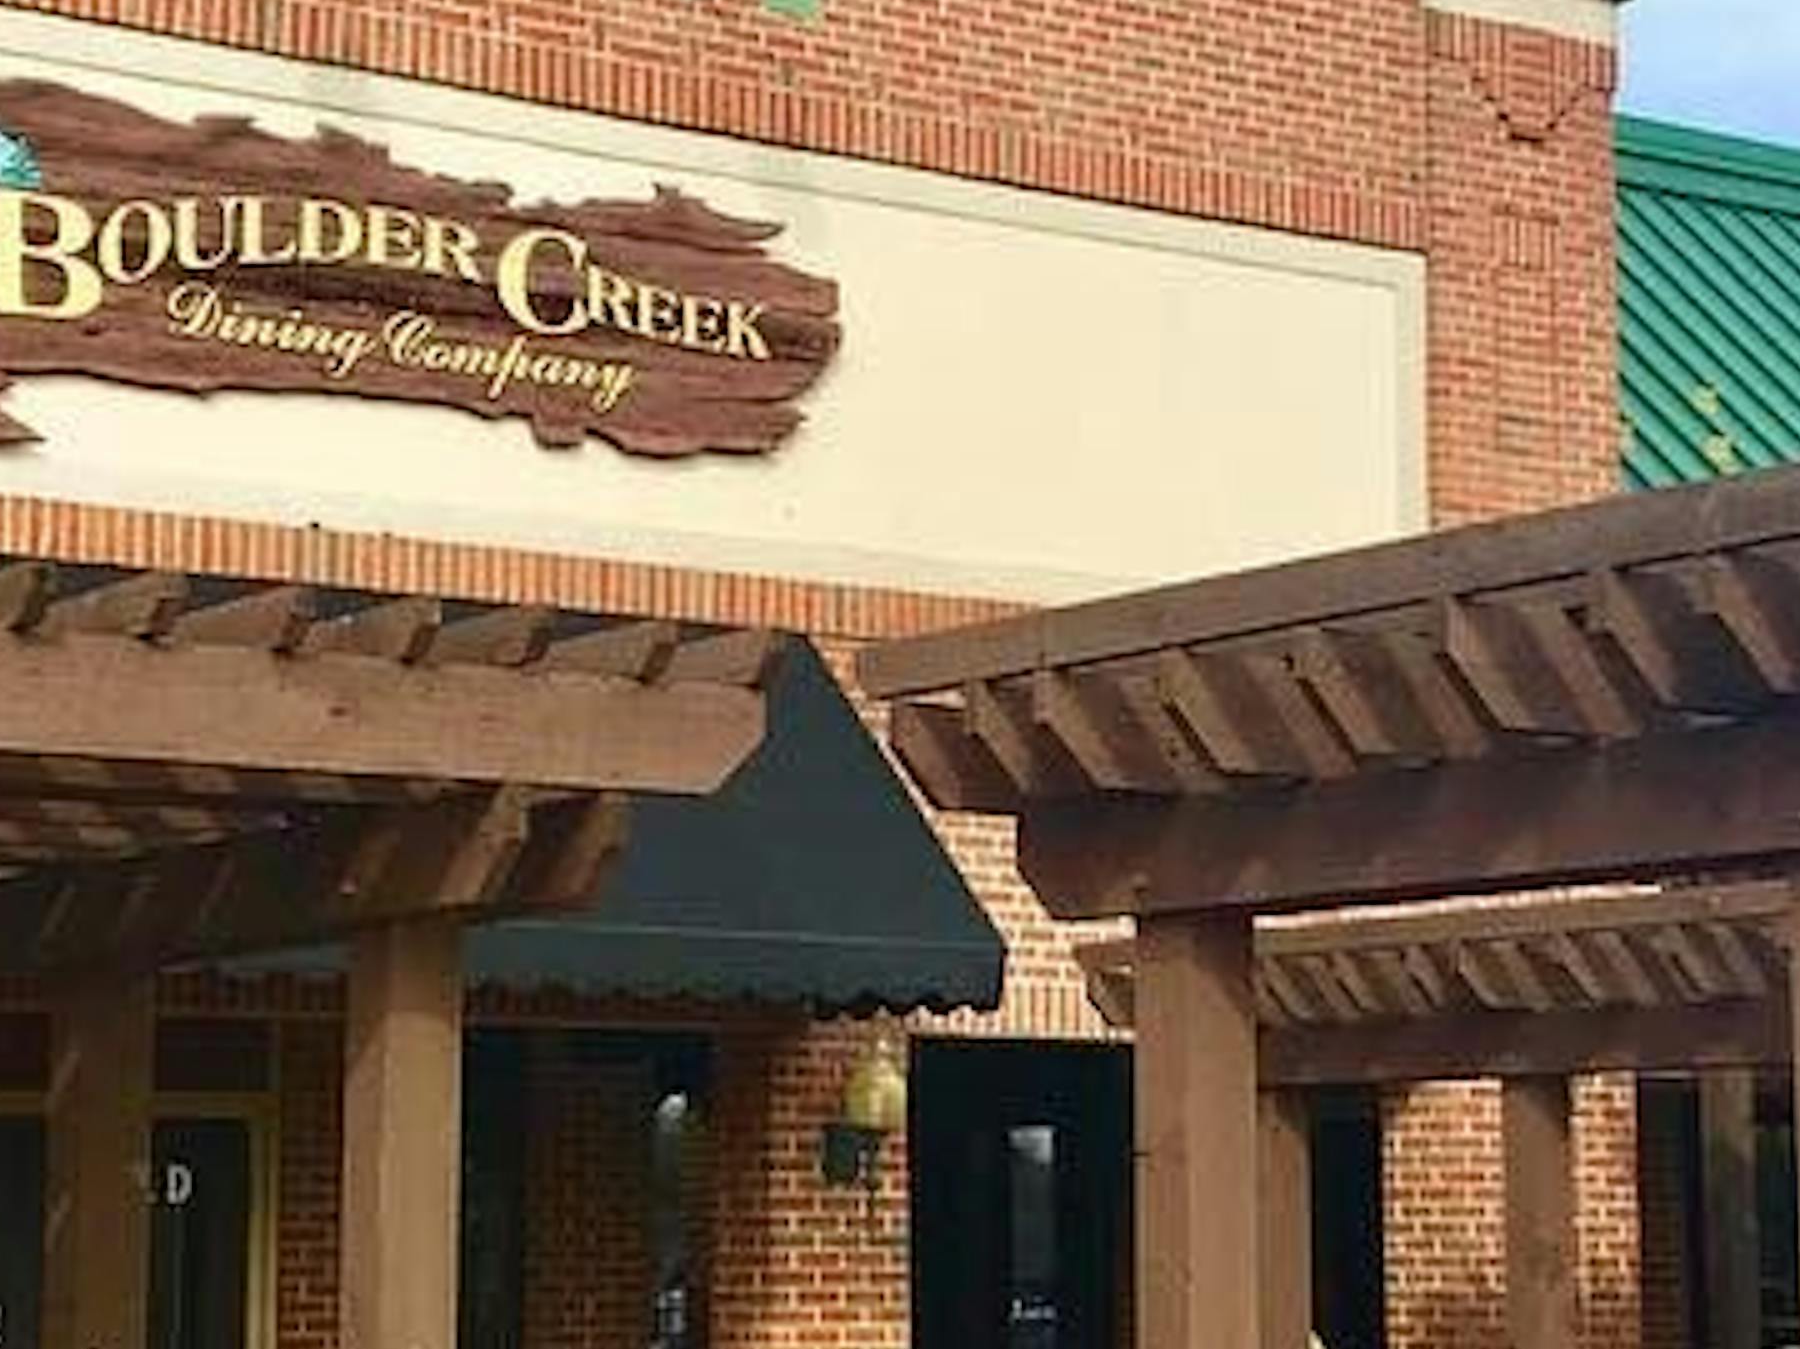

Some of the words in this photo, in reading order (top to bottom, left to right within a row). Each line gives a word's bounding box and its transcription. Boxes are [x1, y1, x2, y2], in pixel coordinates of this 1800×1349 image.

[167, 281, 374, 379] Dining
[382, 308, 639, 413] Company
[498, 229, 771, 361] CREEK
